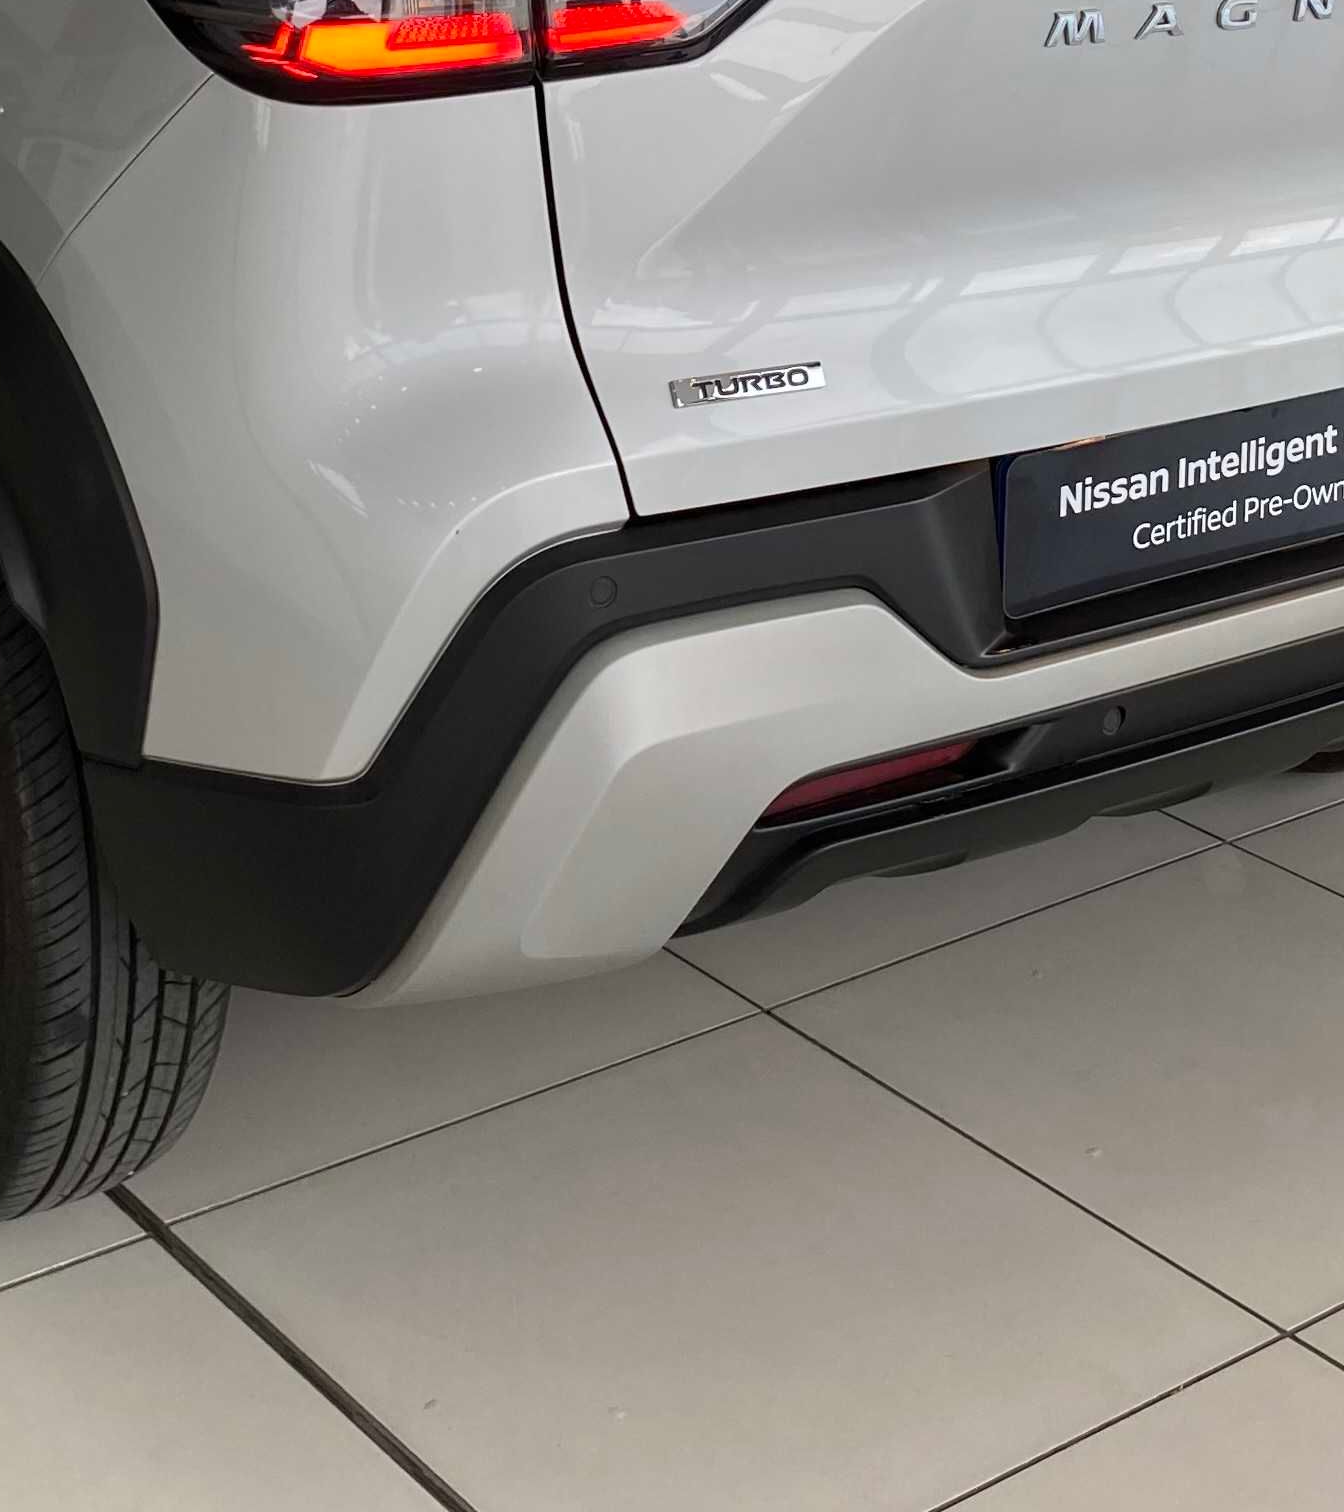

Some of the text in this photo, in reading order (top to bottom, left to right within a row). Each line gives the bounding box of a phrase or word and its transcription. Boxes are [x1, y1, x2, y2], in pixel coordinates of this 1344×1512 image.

[692, 368, 809, 399] TURBO
[1059, 466, 1169, 517] Nissan
[1179, 424, 1337, 489] Intelligent
[1133, 499, 1237, 550] Certified
